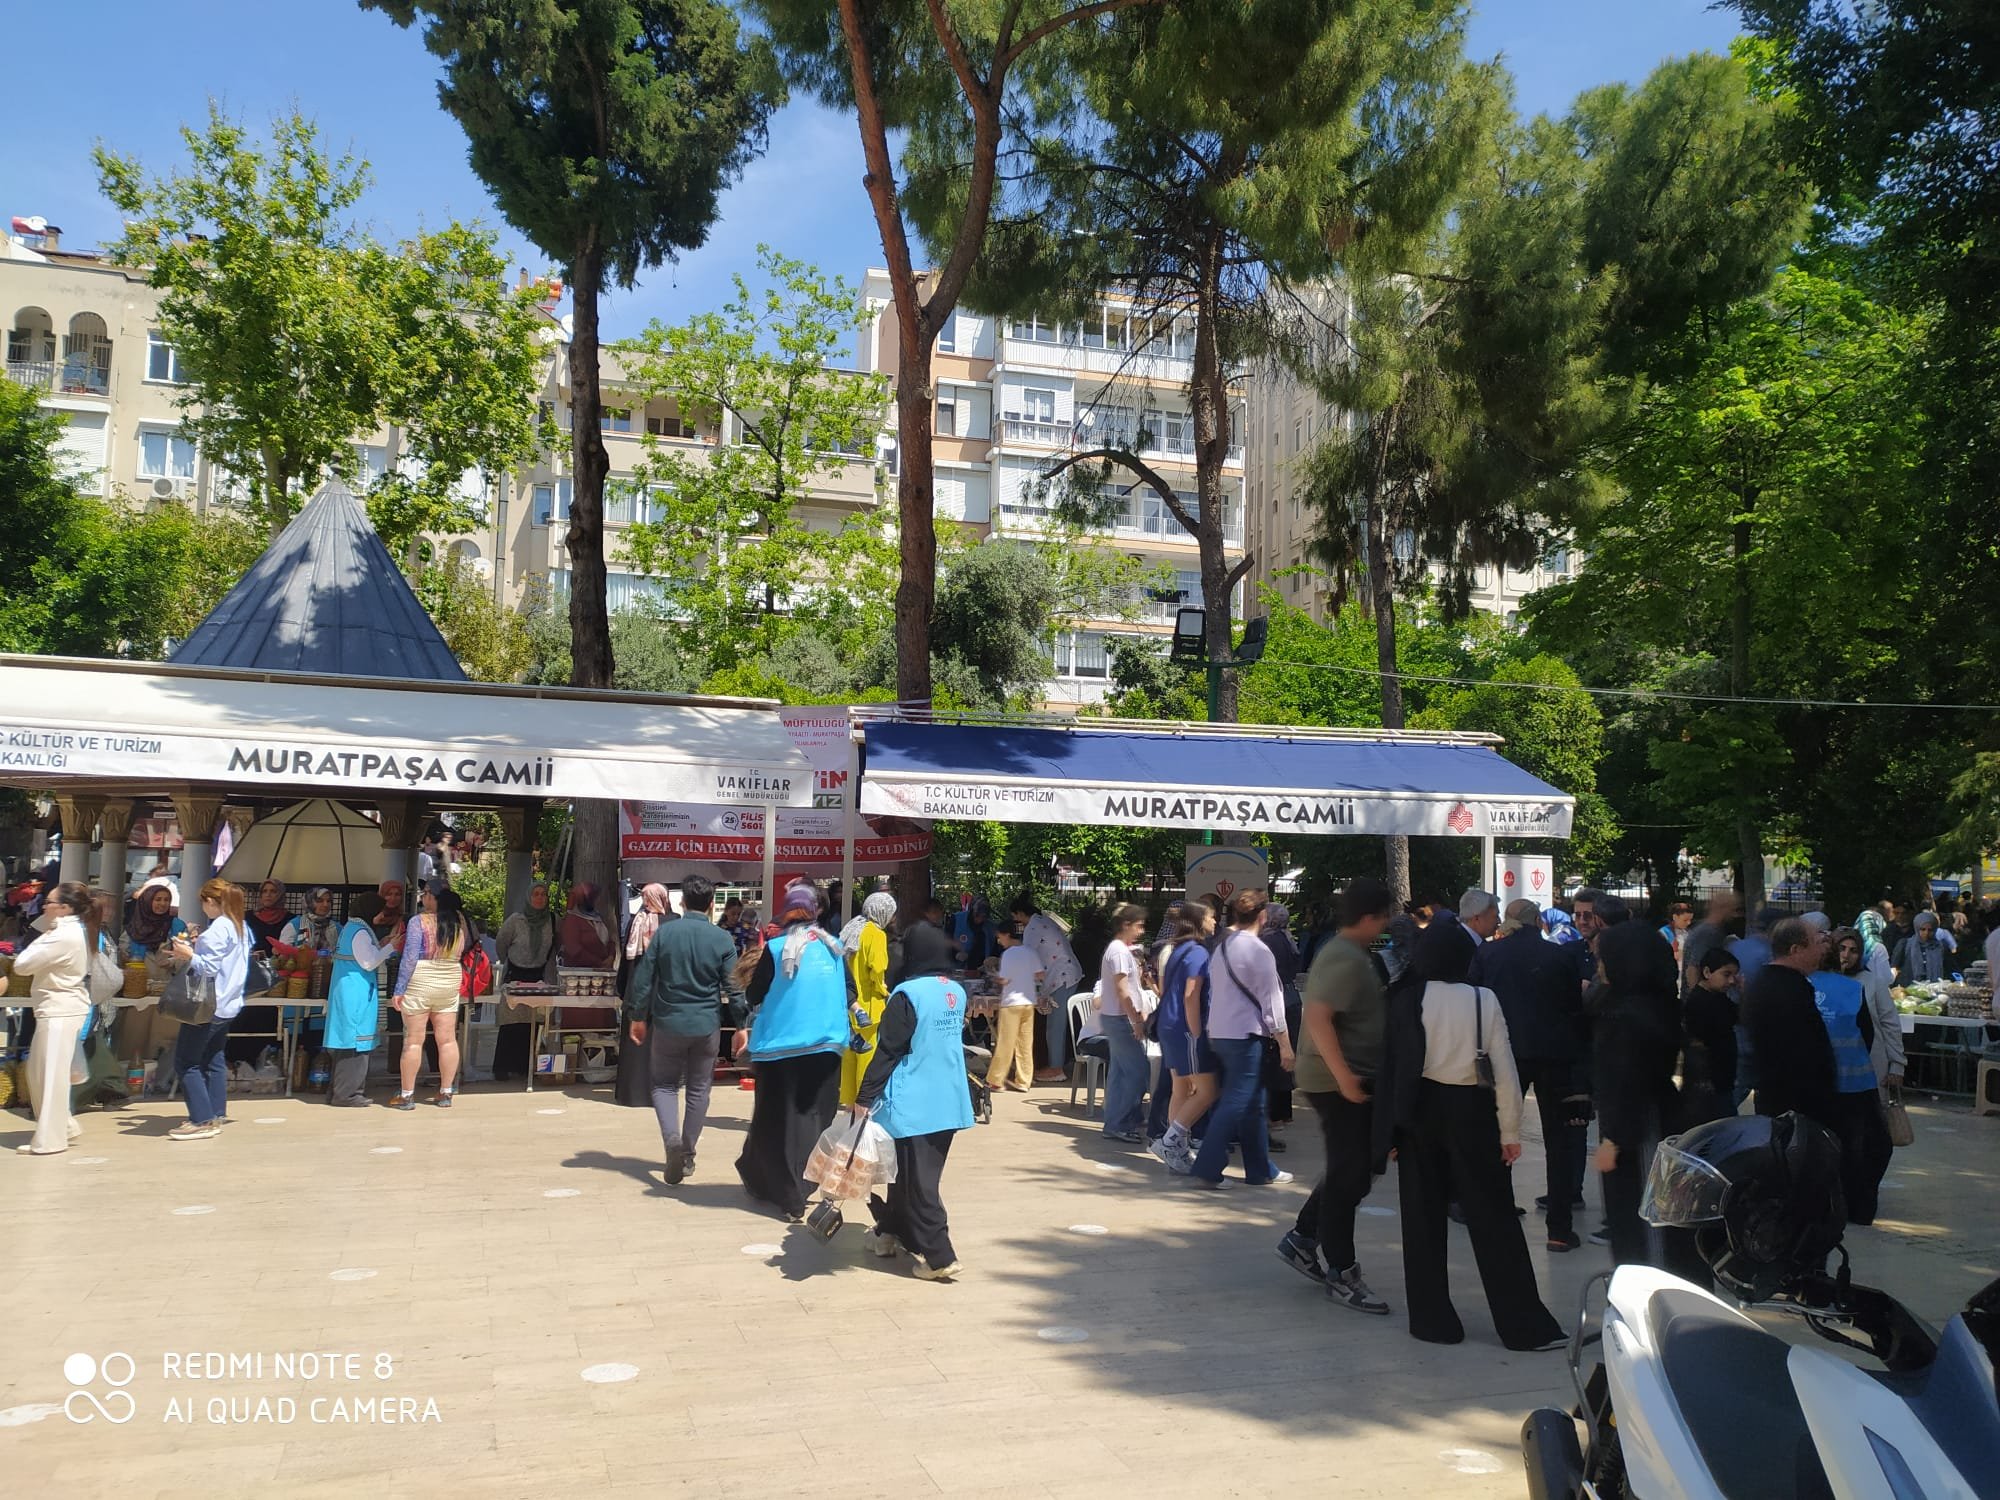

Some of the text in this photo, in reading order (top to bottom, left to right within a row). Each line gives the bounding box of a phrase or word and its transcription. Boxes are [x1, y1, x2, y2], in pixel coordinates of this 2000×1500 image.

[9, 730, 74, 749] KÜLTÜR
[79, 736, 99, 750] VE
[104, 737, 162, 753] TURİZM
[228, 747, 448, 786] MURATPAŞA
[717, 776, 791, 791] VAKIFLAR
[743, 791, 790, 800] MÜDÜRLÜĞÜ
[945, 785, 990, 800] KÜLTÜR
[993, 790, 1009, 801] VE
[1013, 789, 1054, 803] TURİZM
[924, 802, 987, 816] BAKANLIĞI
[1103, 795, 1270, 826] MURATPAŞA
[1490, 811, 1551, 823] VAKIFLAR
[628, 838, 929, 858] GAZZE İÇİN HAYIR ÇRŞIMIZA HŞ GELDİNİZ
